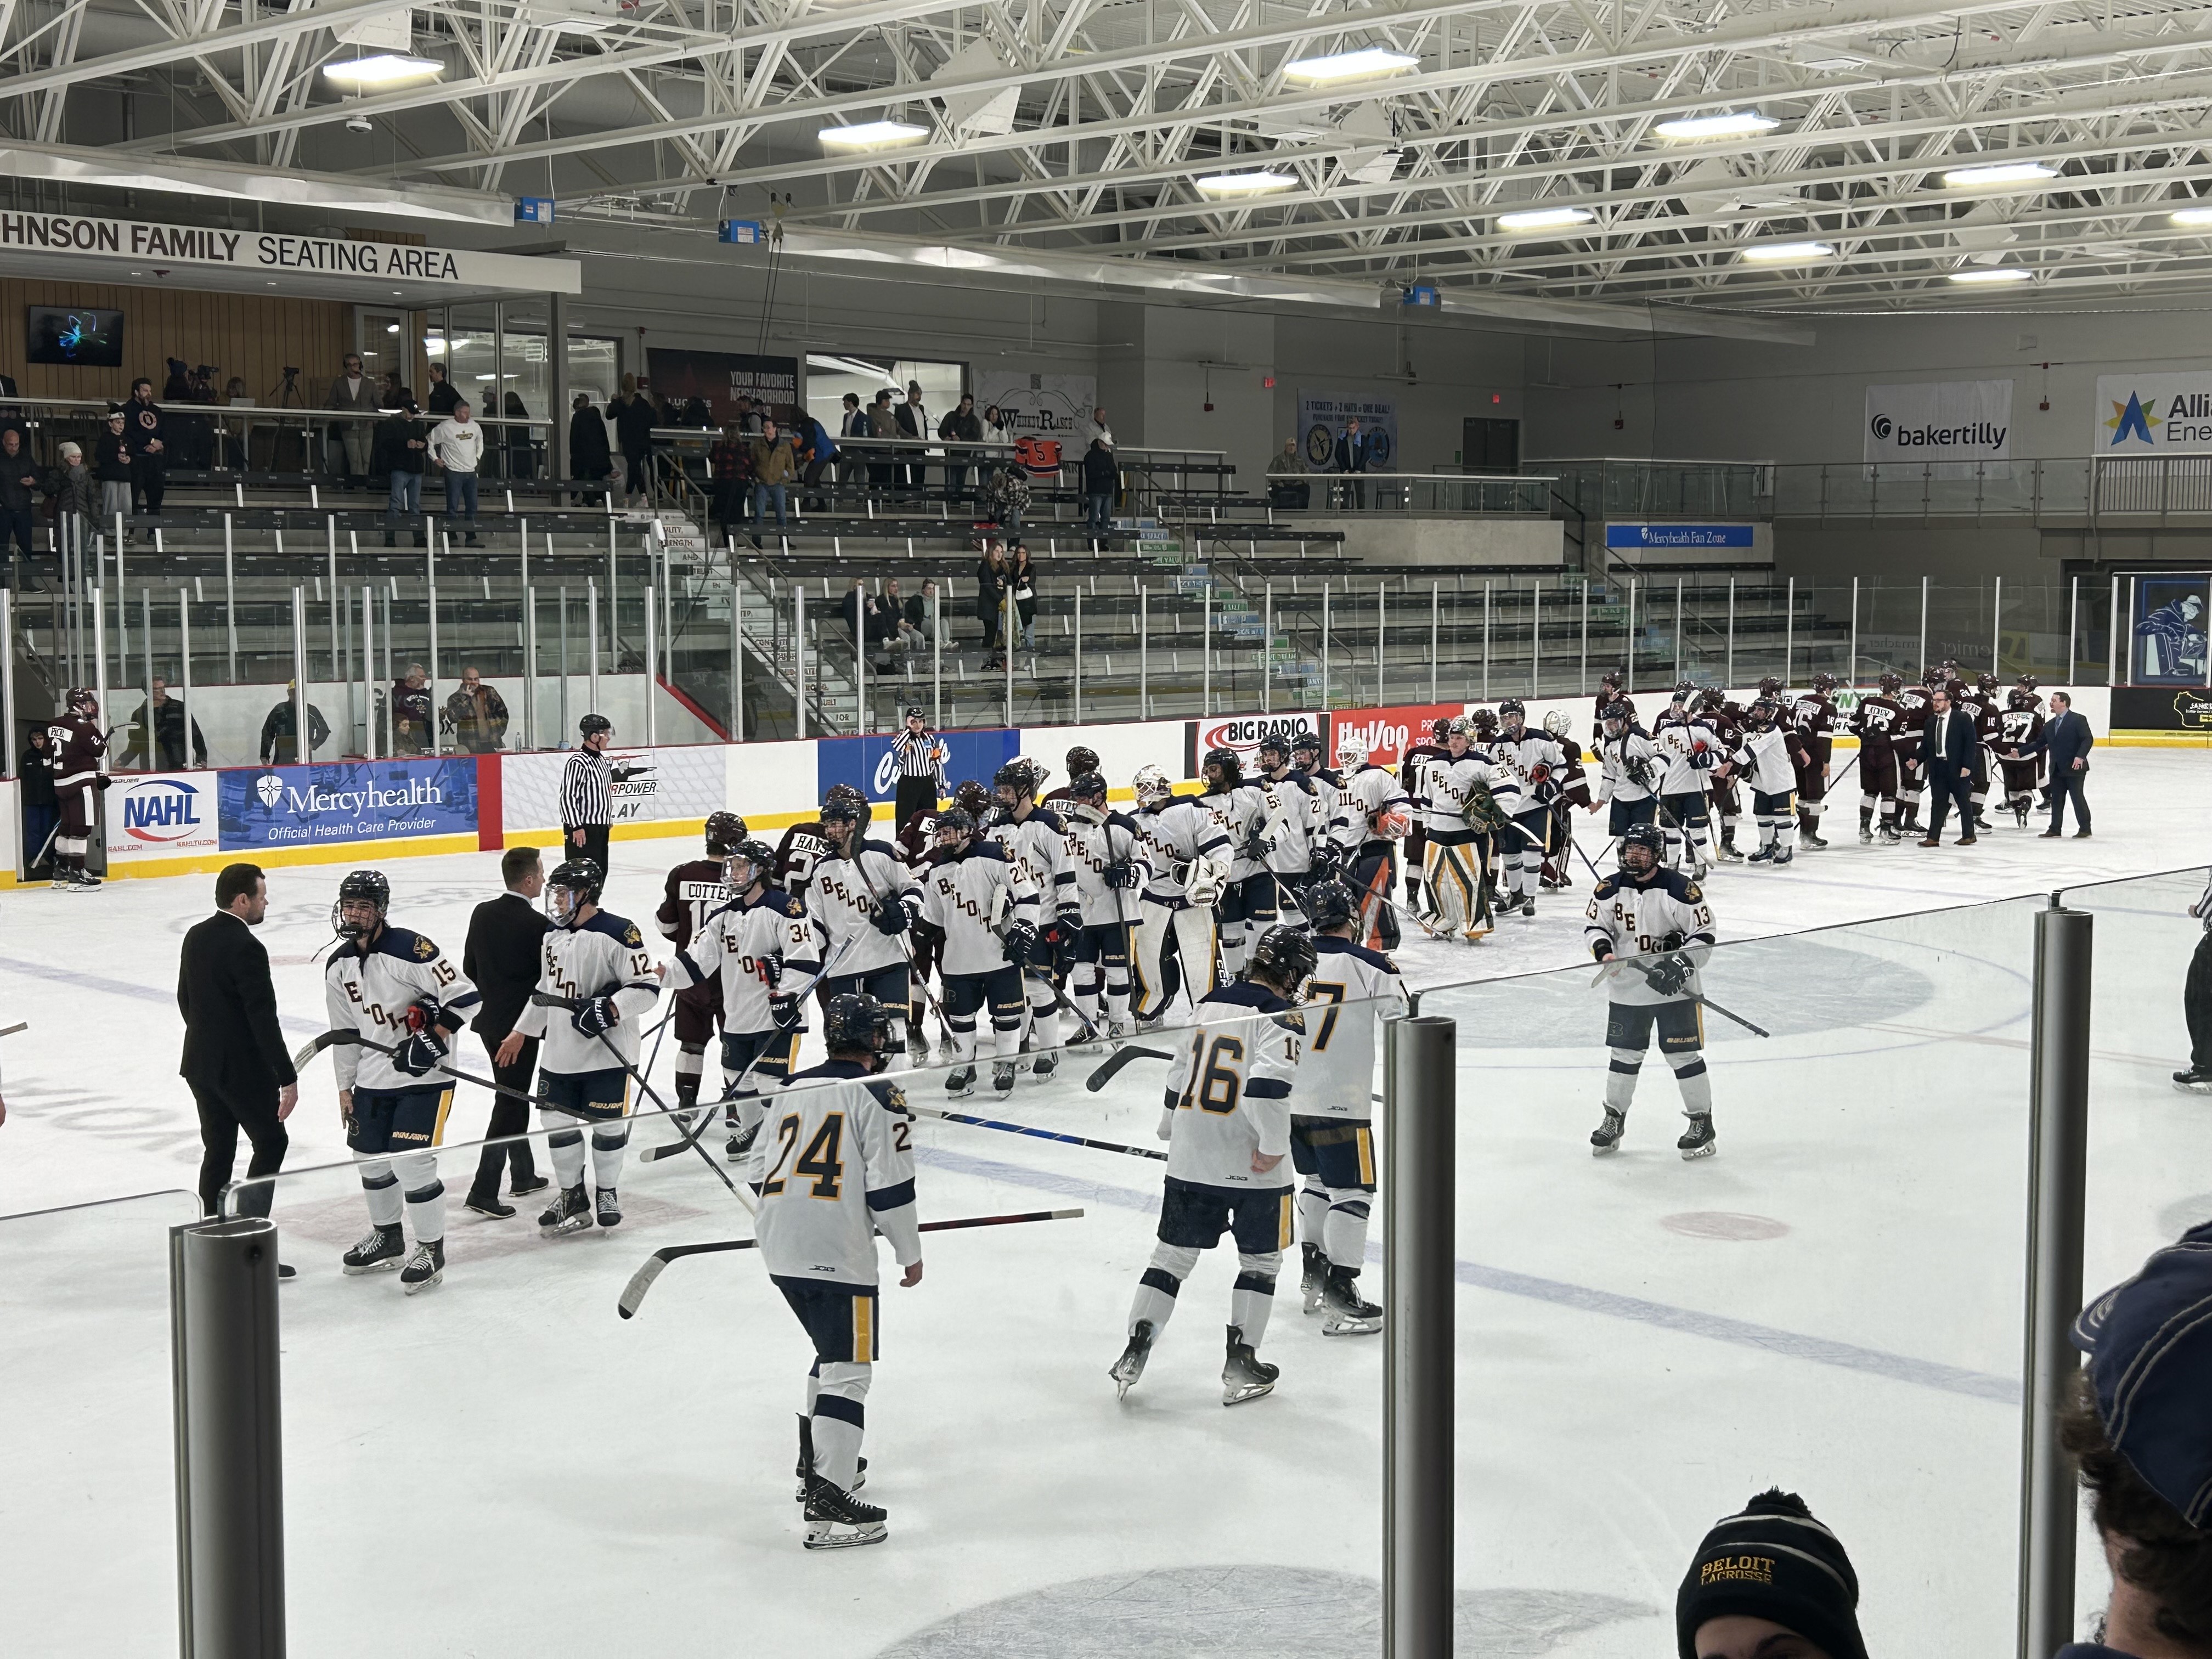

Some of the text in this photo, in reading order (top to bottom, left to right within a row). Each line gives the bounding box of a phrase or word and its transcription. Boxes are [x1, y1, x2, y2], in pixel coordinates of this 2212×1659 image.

[131, 225, 240, 261] FAMILY
[258, 236, 377, 273] SEATING
[387, 248, 459, 279] AREA
[730, 371, 794, 389] YOUR FAVORITE
[2169, 394, 2212, 419] Alli
[1898, 422, 2007, 450] bakertilly
[1228, 718, 1308, 741] BIG RADIO
[2002, 718, 2034, 743] 27
[287, 777, 443, 817] Mercyhealth
[124, 794, 201, 828] NAHL
[269, 817, 436, 840] Official Health Care Provider
[1694, 906, 1711, 927] 13
[789, 923, 811, 943] 34
[432, 959, 456, 988] 15
[630, 953, 652, 976] 12
[1179, 1029, 1244, 1117] 16
[762, 1110, 846, 1201] 24
[1701, 1555, 1775, 1577] BELOIT
[1701, 1570, 1773, 1586] LACROSSE
